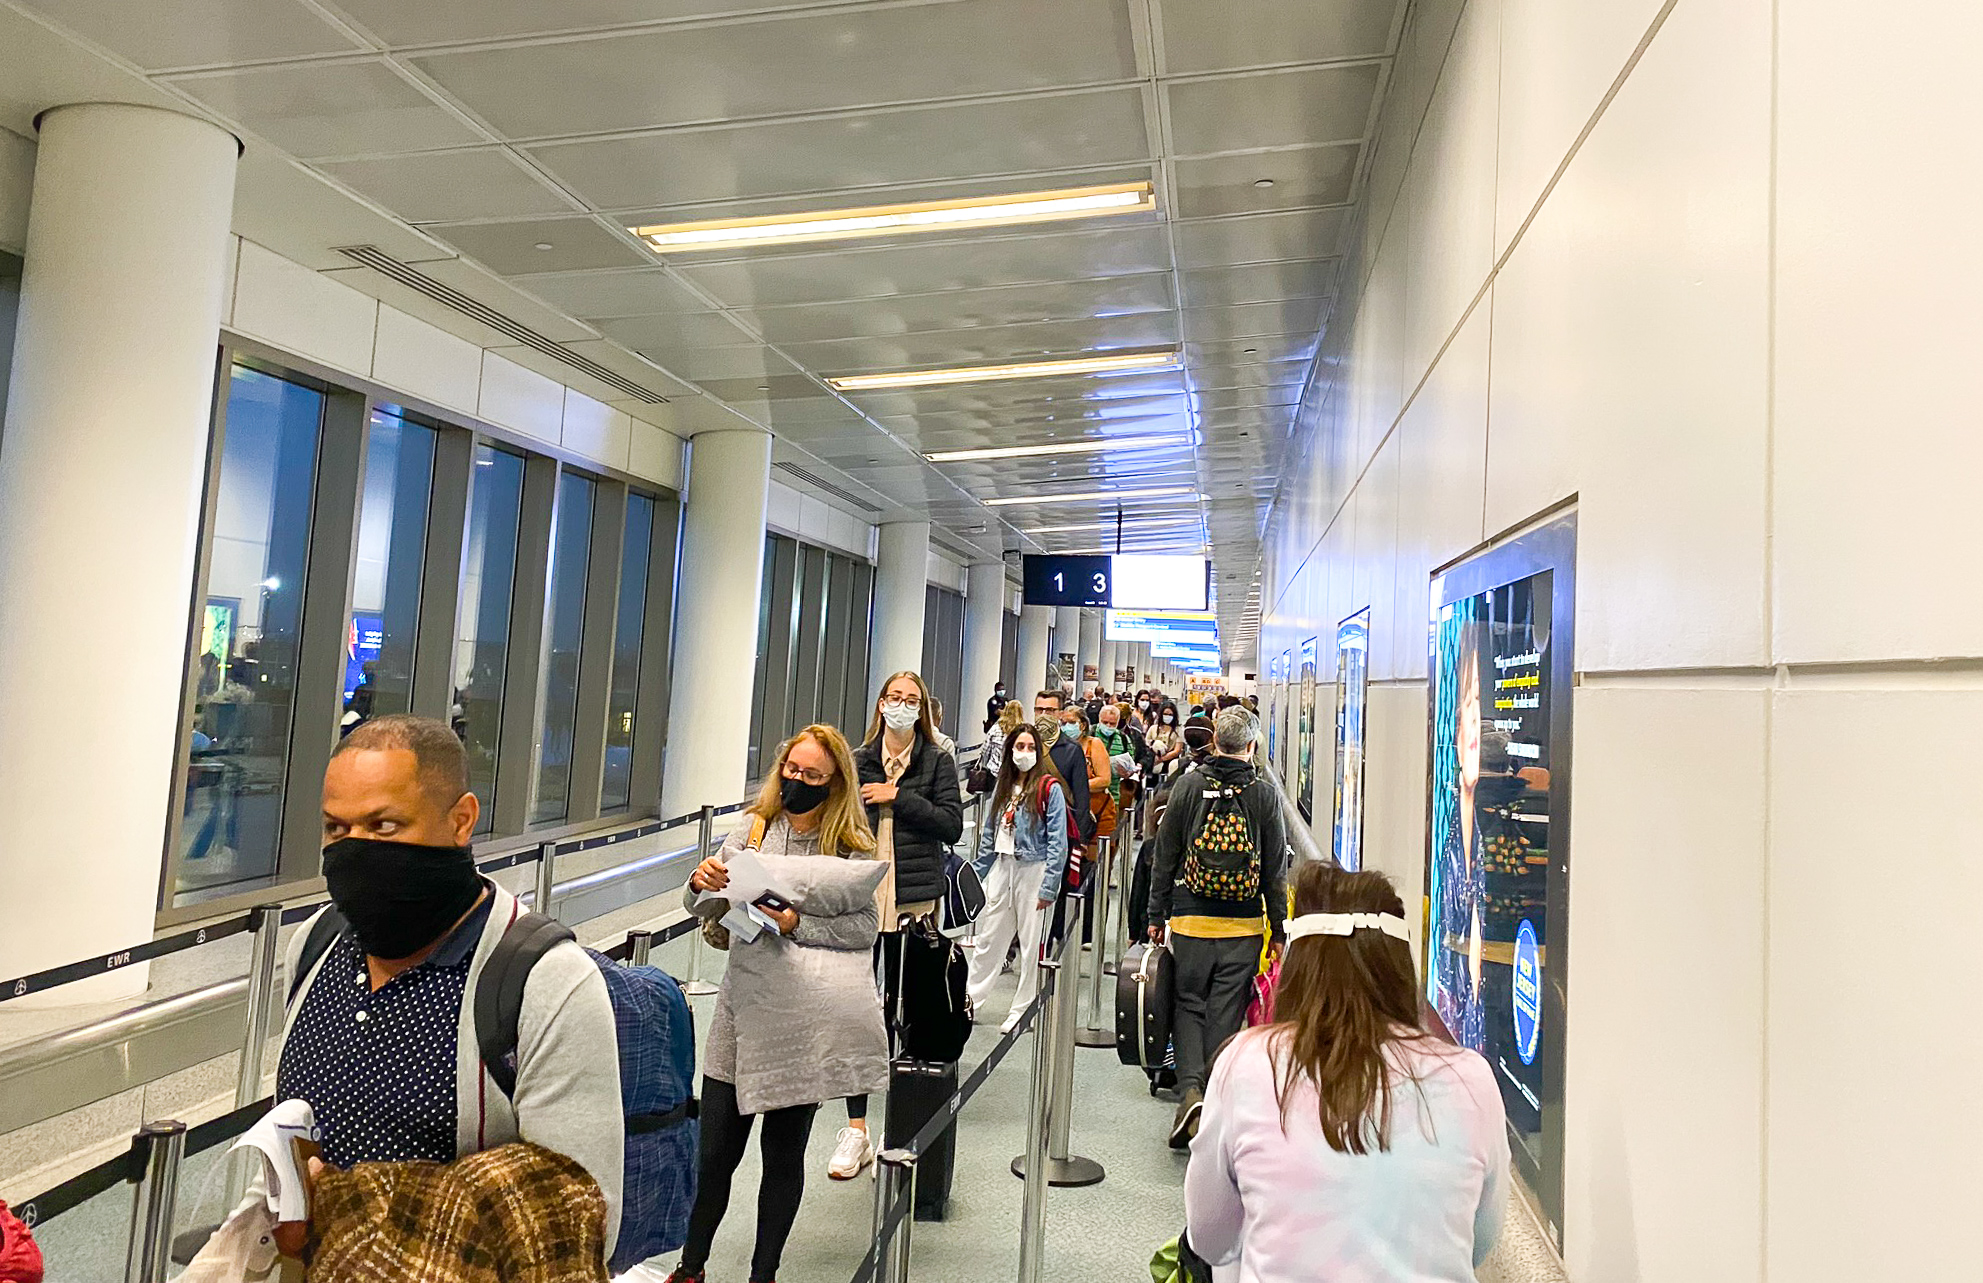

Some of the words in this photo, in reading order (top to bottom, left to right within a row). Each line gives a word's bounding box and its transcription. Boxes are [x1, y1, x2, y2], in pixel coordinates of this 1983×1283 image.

[1053, 571, 1063, 592] 1
[1093, 572, 1107, 593] 3
[107, 951, 130, 968] EWR
